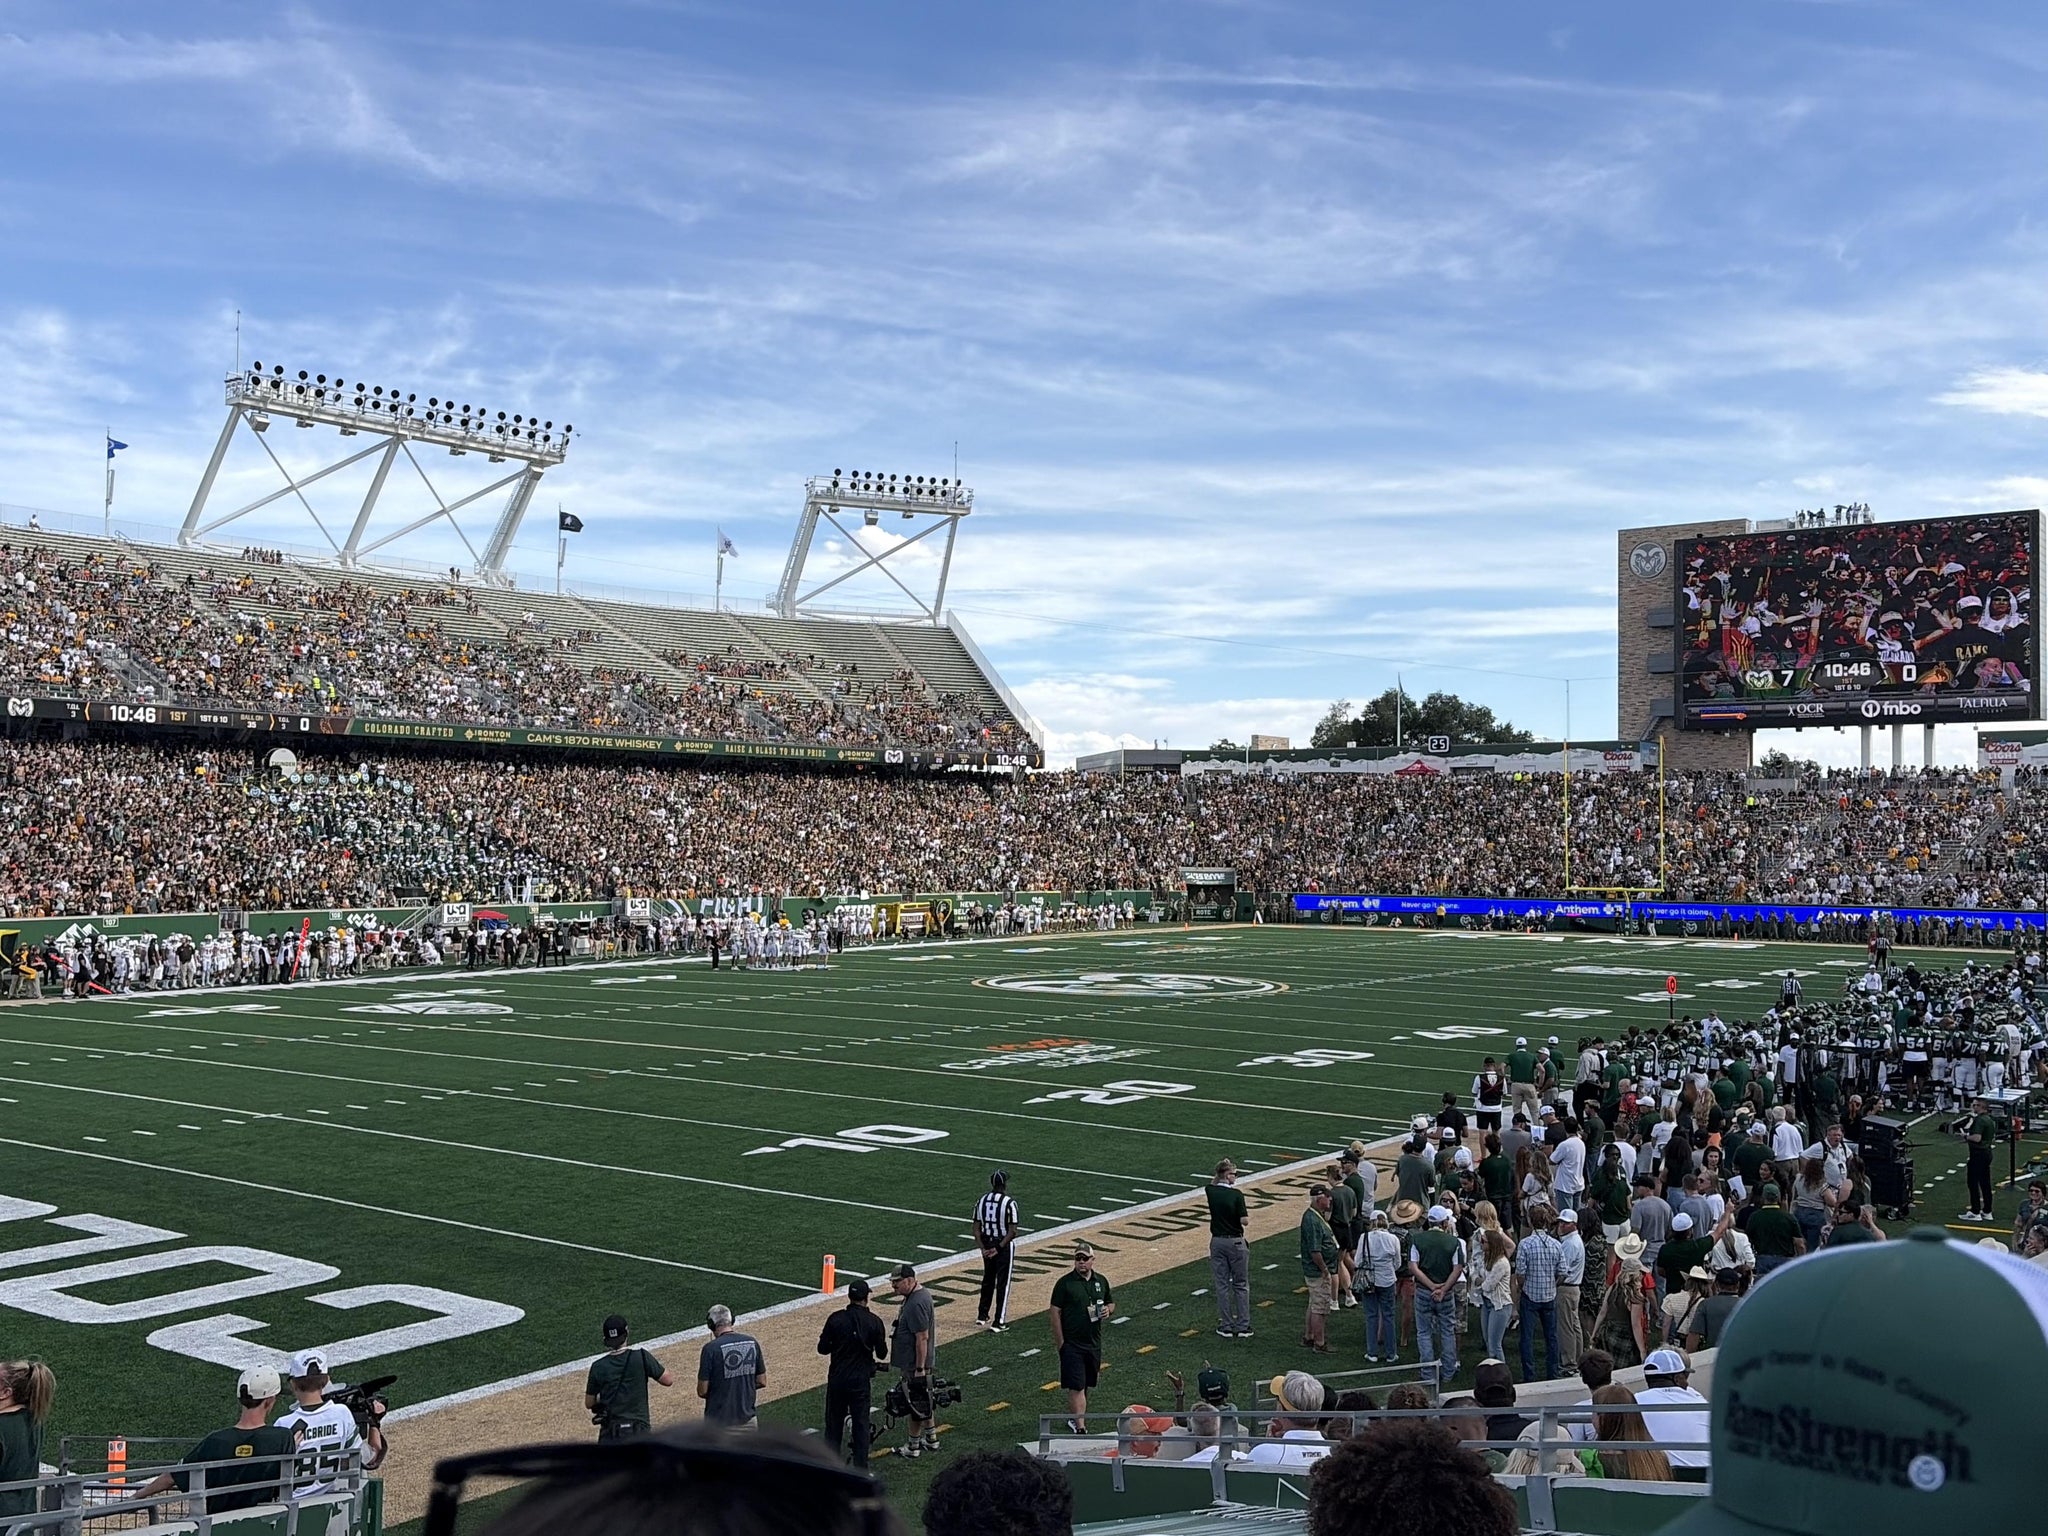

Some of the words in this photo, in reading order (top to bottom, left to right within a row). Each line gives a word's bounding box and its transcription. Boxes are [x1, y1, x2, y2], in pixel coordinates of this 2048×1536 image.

[1824, 662, 1871, 677] 10:46
[1902, 665, 1917, 682] 0
[1781, 670, 1794, 686] 7
[110, 705, 157, 723] 10:46
[1796, 703, 1824, 713] OCR
[1883, 701, 1922, 716] fnbo
[170, 711, 187, 721] 1ST
[300, 718, 310, 731] 0
[364, 723, 411, 735] COLORADO
[414, 725, 454, 737] CRAFTED
[474, 729, 511, 738] IRONTON
[527, 733, 562, 743] CAM'S
[564, 735, 590, 745] 1870
[591, 737, 613, 747] RYE
[614, 738, 663, 749] WHISKEY
[682, 742, 714, 750] IRONTON
[1431, 740, 1446, 749] 25
[1985, 741, 2023, 753] Coors
[725, 744, 746, 754] RAISE
[755, 746, 777, 755] GLASS
[779, 747, 788, 756] TO
[807, 748, 827, 758] PRIDE
[1603, 750, 1633, 761] Coors
[996, 755, 1027, 766] 10:46
[1318, 899, 1358, 909] Antem
[1520, 1007, 1613, 1019] 50
[1413, 1025, 1509, 1040] 40
[1906, 1036, 1924, 1049] 54
[1961, 1041, 1978, 1054] 70
[1253, 1048, 1375, 1067] 30
[1046, 1079, 1196, 1105] 20
[778, 1124, 950, 1153] 10
[984, 1202, 998, 1222] H
[0, 1194, 526, 1375] COL
[303, 1423, 338, 1441] CBRIDE
